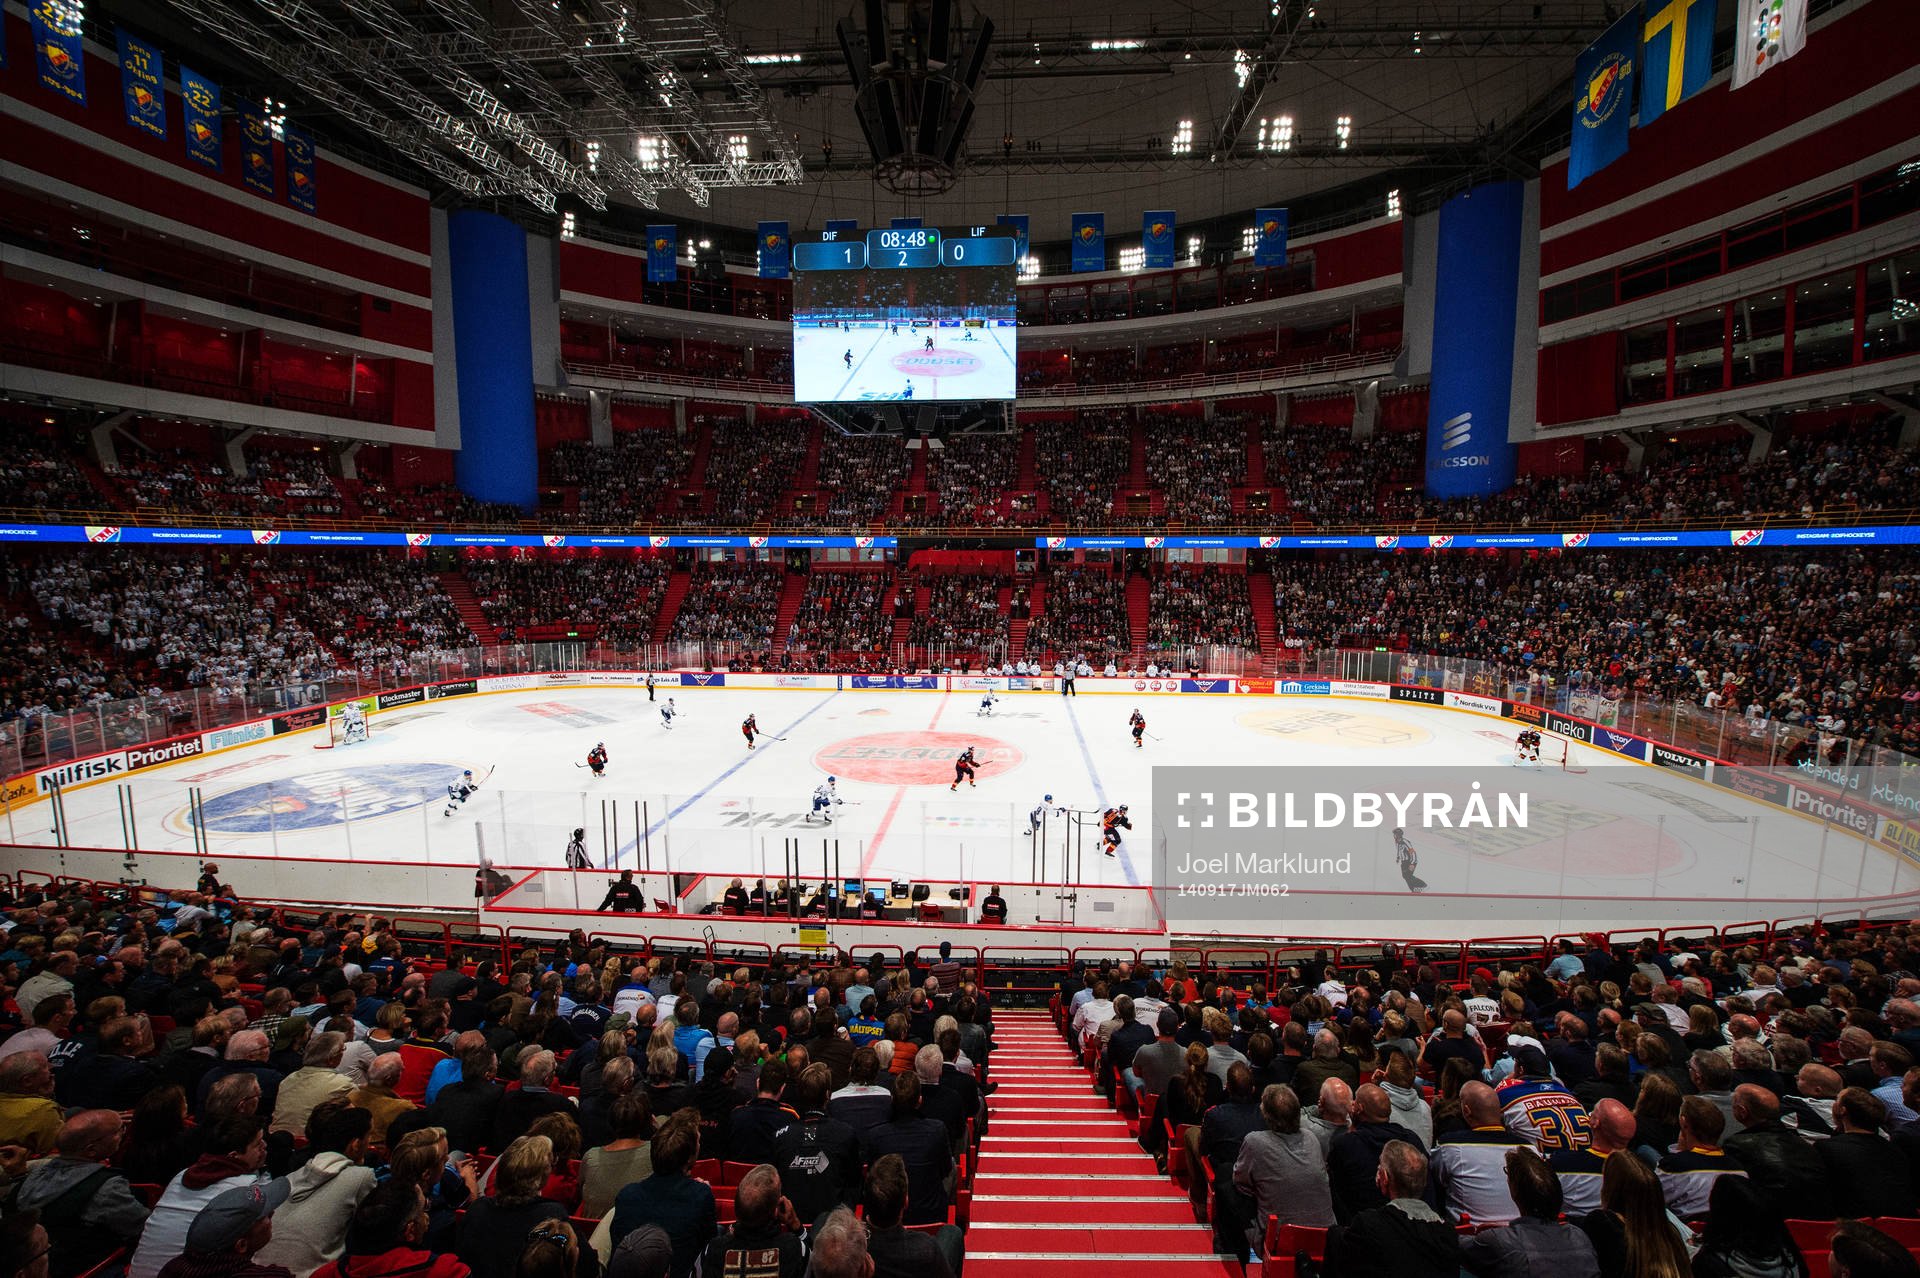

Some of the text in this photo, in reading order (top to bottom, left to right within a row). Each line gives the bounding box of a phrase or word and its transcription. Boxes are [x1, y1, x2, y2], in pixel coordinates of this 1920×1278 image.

[193, 90, 211, 108] 22
[822, 231, 838, 241] DIF
[880, 231, 926, 248] 08:48
[971, 227, 986, 237] LIF
[844, 248, 851, 264] 1
[898, 251, 908, 267] 2
[953, 245, 964, 260] 0
[441, 682, 469, 690] CERTINA
[381, 690, 421, 703] Klockmaster
[1399, 689, 1435, 701] SPLITZ
[1459, 700, 1496, 711] Nordisk VVS
[1512, 703, 1541, 719] KAKEL
[210, 723, 266, 750] Flinks
[1553, 719, 1585, 740] ineko
[127, 738, 201, 768] Prioritet
[1655, 748, 1703, 770] VOLVIA
[41, 756, 123, 792] Nilfisk
[1797, 757, 1859, 790] xtended
[1470, 1004, 1495, 1013] FALCON
[1527, 1105, 1593, 1152] 35
